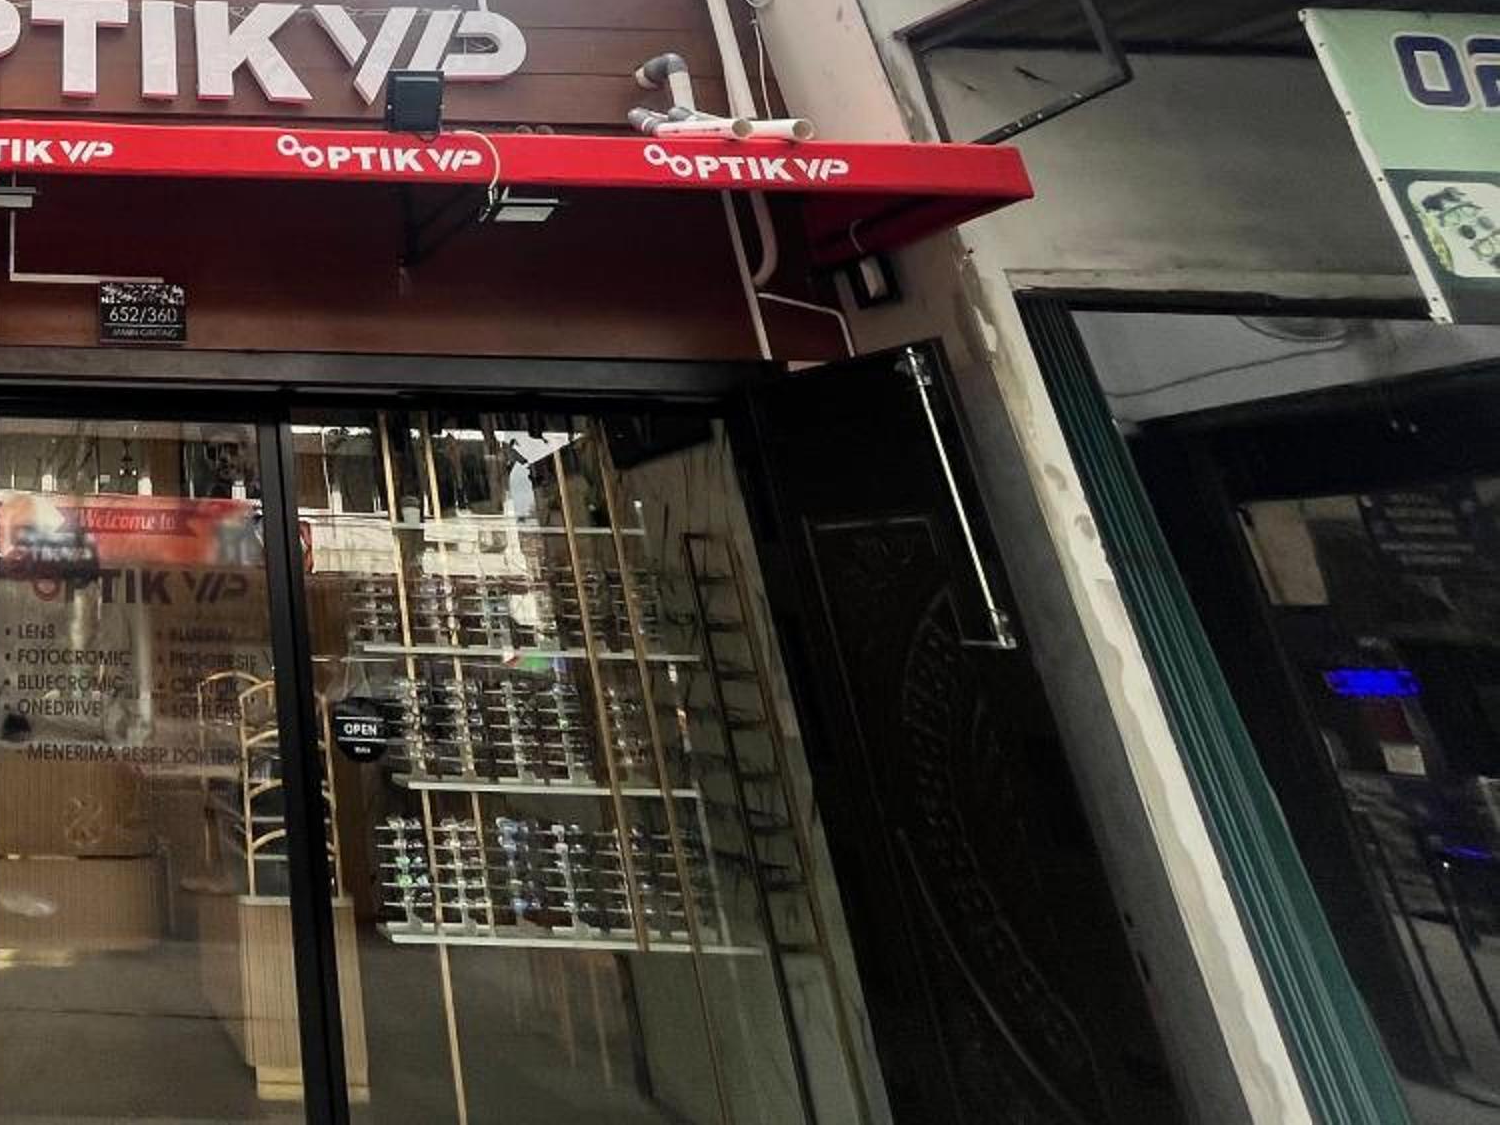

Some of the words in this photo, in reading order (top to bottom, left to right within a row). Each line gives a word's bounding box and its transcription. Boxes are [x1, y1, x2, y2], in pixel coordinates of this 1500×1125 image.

[109, 306, 178, 323] 652/360
[81, 508, 156, 532] Welcome
[17, 621, 56, 640] LENS
[17, 698, 103, 717] ONEDRIVE
[343, 722, 377, 736] OPEN
[26, 743, 117, 763] MENERIMA
